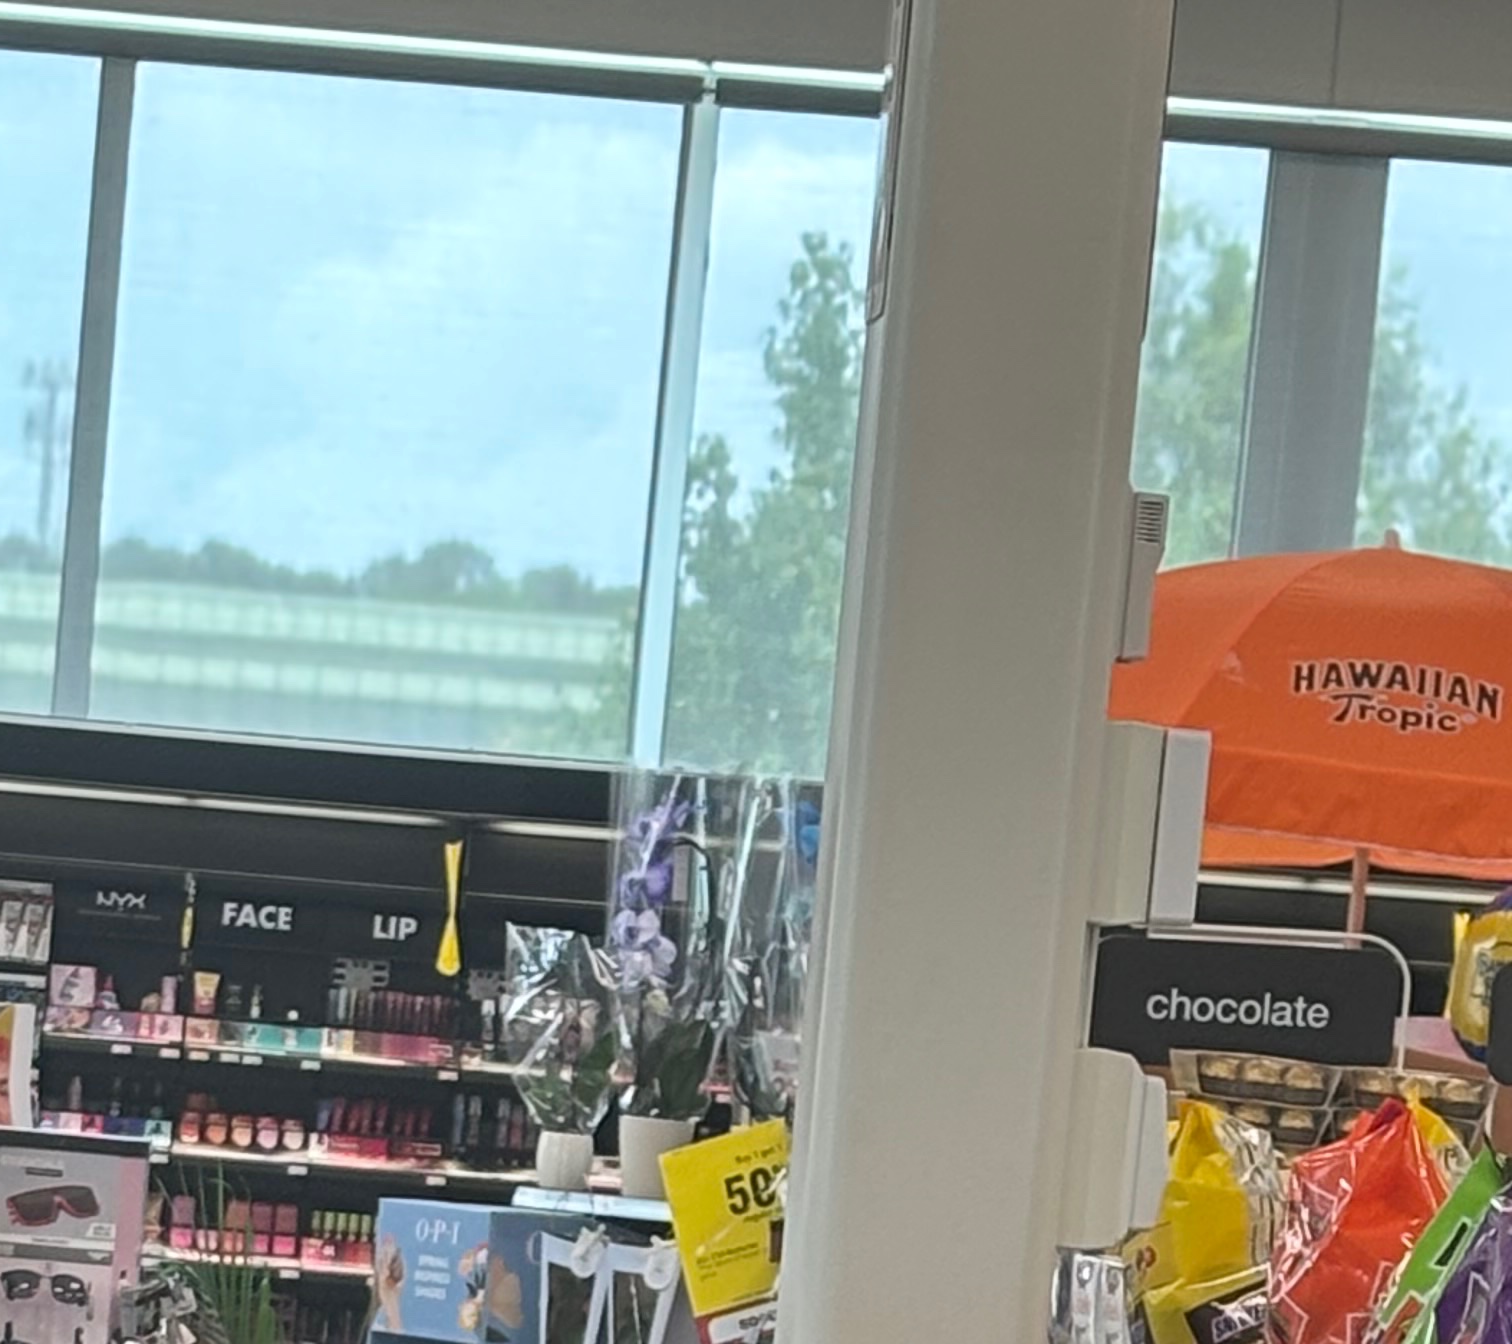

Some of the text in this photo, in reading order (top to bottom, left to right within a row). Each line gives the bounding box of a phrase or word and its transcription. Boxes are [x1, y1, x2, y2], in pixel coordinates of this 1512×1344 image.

[1293, 662, 1500, 720] HAWAIIAN
[1330, 694, 1458, 732] Tropic
[96, 891, 146, 912] NYX
[222, 902, 293, 932] FACE
[373, 915, 418, 941] LIP
[1146, 988, 1330, 1028] chocolate
